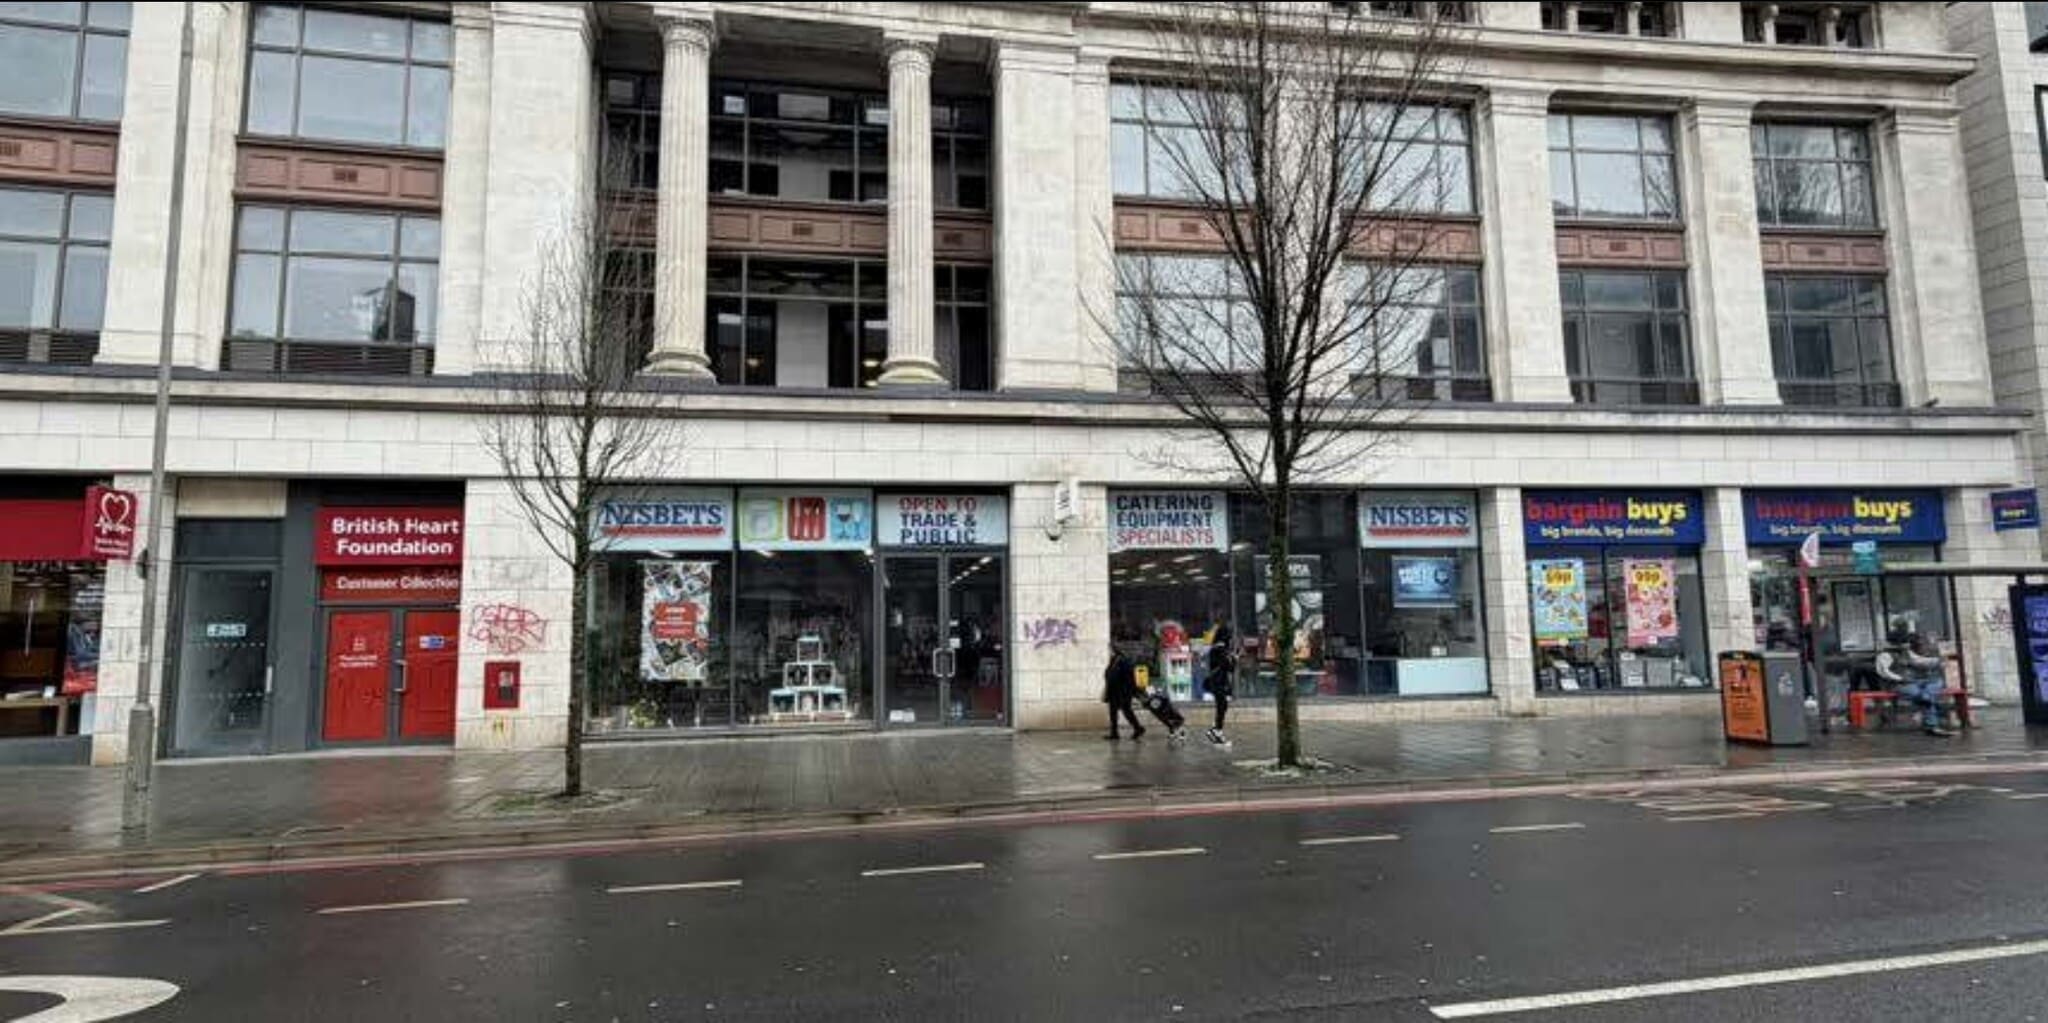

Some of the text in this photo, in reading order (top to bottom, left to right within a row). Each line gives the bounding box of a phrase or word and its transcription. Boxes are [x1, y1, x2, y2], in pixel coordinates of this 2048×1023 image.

[899, 496, 977, 511] OPEN TO
[1116, 495, 1213, 510] CATERING
[1853, 497, 1912, 522] buys
[602, 503, 723, 525] NISBETS
[901, 512, 977, 527] TRADE &
[1117, 511, 1213, 527] EQUIPMENT
[1370, 506, 1467, 525] NISBETS
[1527, 498, 1687, 526] bargain buys
[332, 517, 459, 535] British Heart
[1541, 524, 1560, 538] big
[1604, 524, 1624, 538] big
[901, 528, 976, 545] PUBLIC
[1116, 529, 1214, 544] SPECIALISTS
[336, 537, 454, 556] Foundation
[336, 574, 459, 590] Customer Collection
